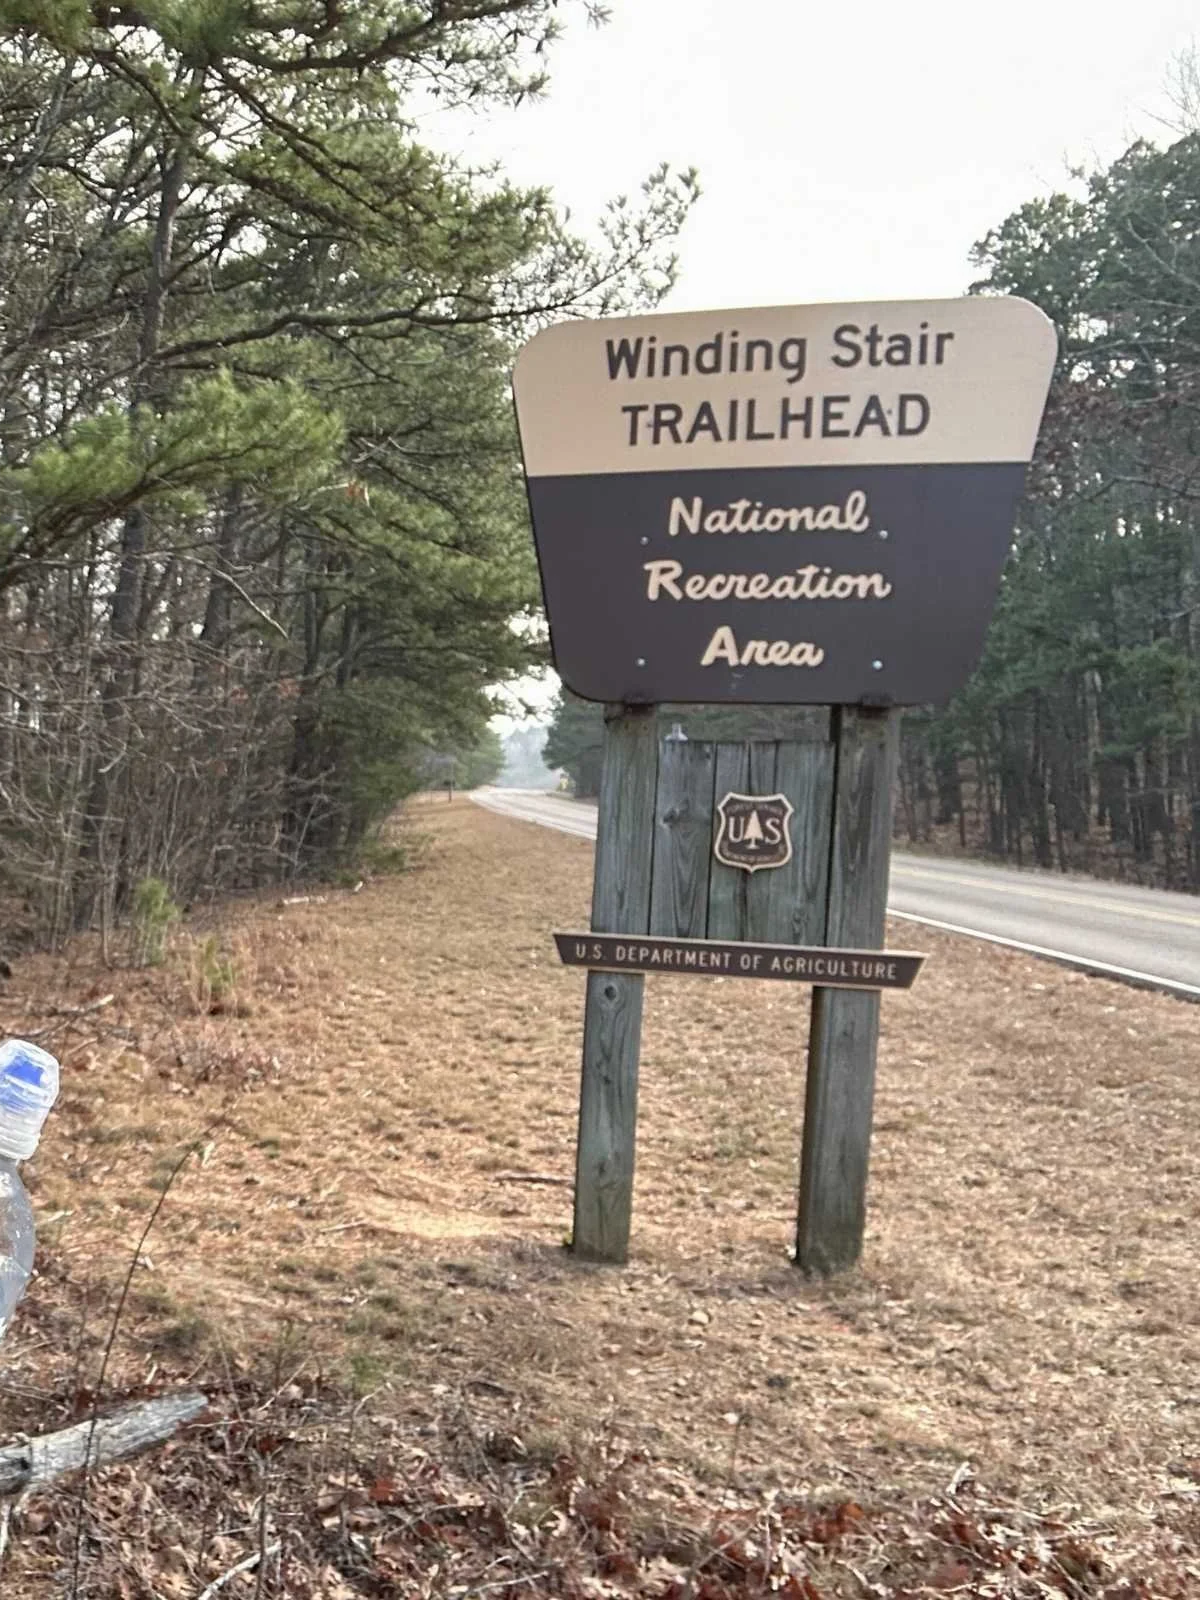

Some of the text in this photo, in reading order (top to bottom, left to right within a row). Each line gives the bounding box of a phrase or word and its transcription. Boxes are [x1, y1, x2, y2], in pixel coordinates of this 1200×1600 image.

[605, 321, 955, 384] Winding Stair
[621, 392, 932, 447] TRAILHEAD
[668, 490, 870, 537] National
[643, 560, 892, 602] Recreation
[700, 625, 825, 668] Area
[576, 943, 897, 980] U.S. DEPARTMENT OF AGRICULTURE
